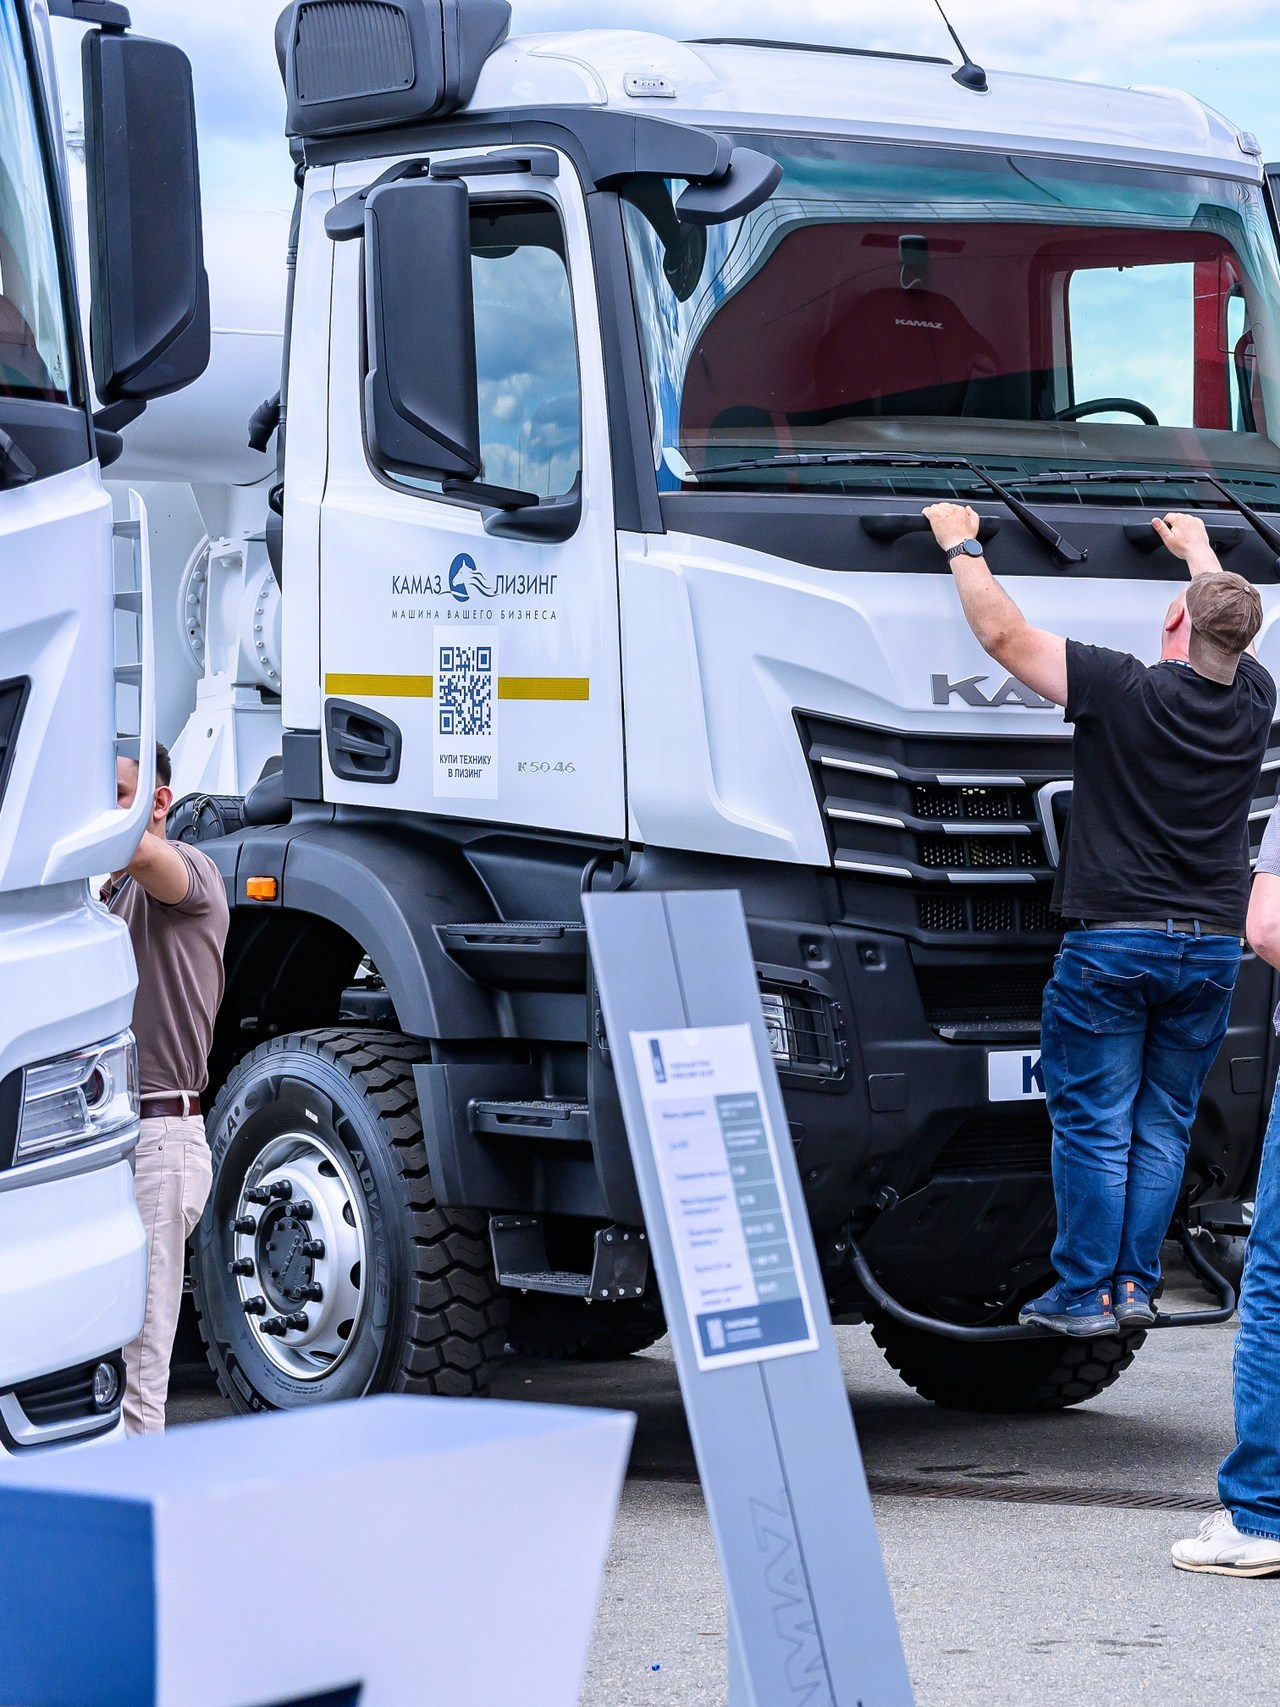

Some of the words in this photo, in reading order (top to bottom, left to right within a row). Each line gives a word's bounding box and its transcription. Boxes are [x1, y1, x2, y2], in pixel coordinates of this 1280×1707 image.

[895, 318, 944, 330] KAMAZ
[391, 575, 442, 595] КАМАЗ
[494, 574, 558, 595] ЛИЗИНГ
[391, 609, 440, 620] МАШИНА
[447, 609, 493, 620] ВАШЕГО
[500, 610, 557, 620] БИЗНЕСА
[439, 754, 458, 764] КУПИ
[459, 754, 492, 765] ТЕХНИКУ
[447, 768, 453, 778] В
[454, 768, 483, 779] ЛИЗИНГ
[350, 1150, 388, 1298] ADVANCE
